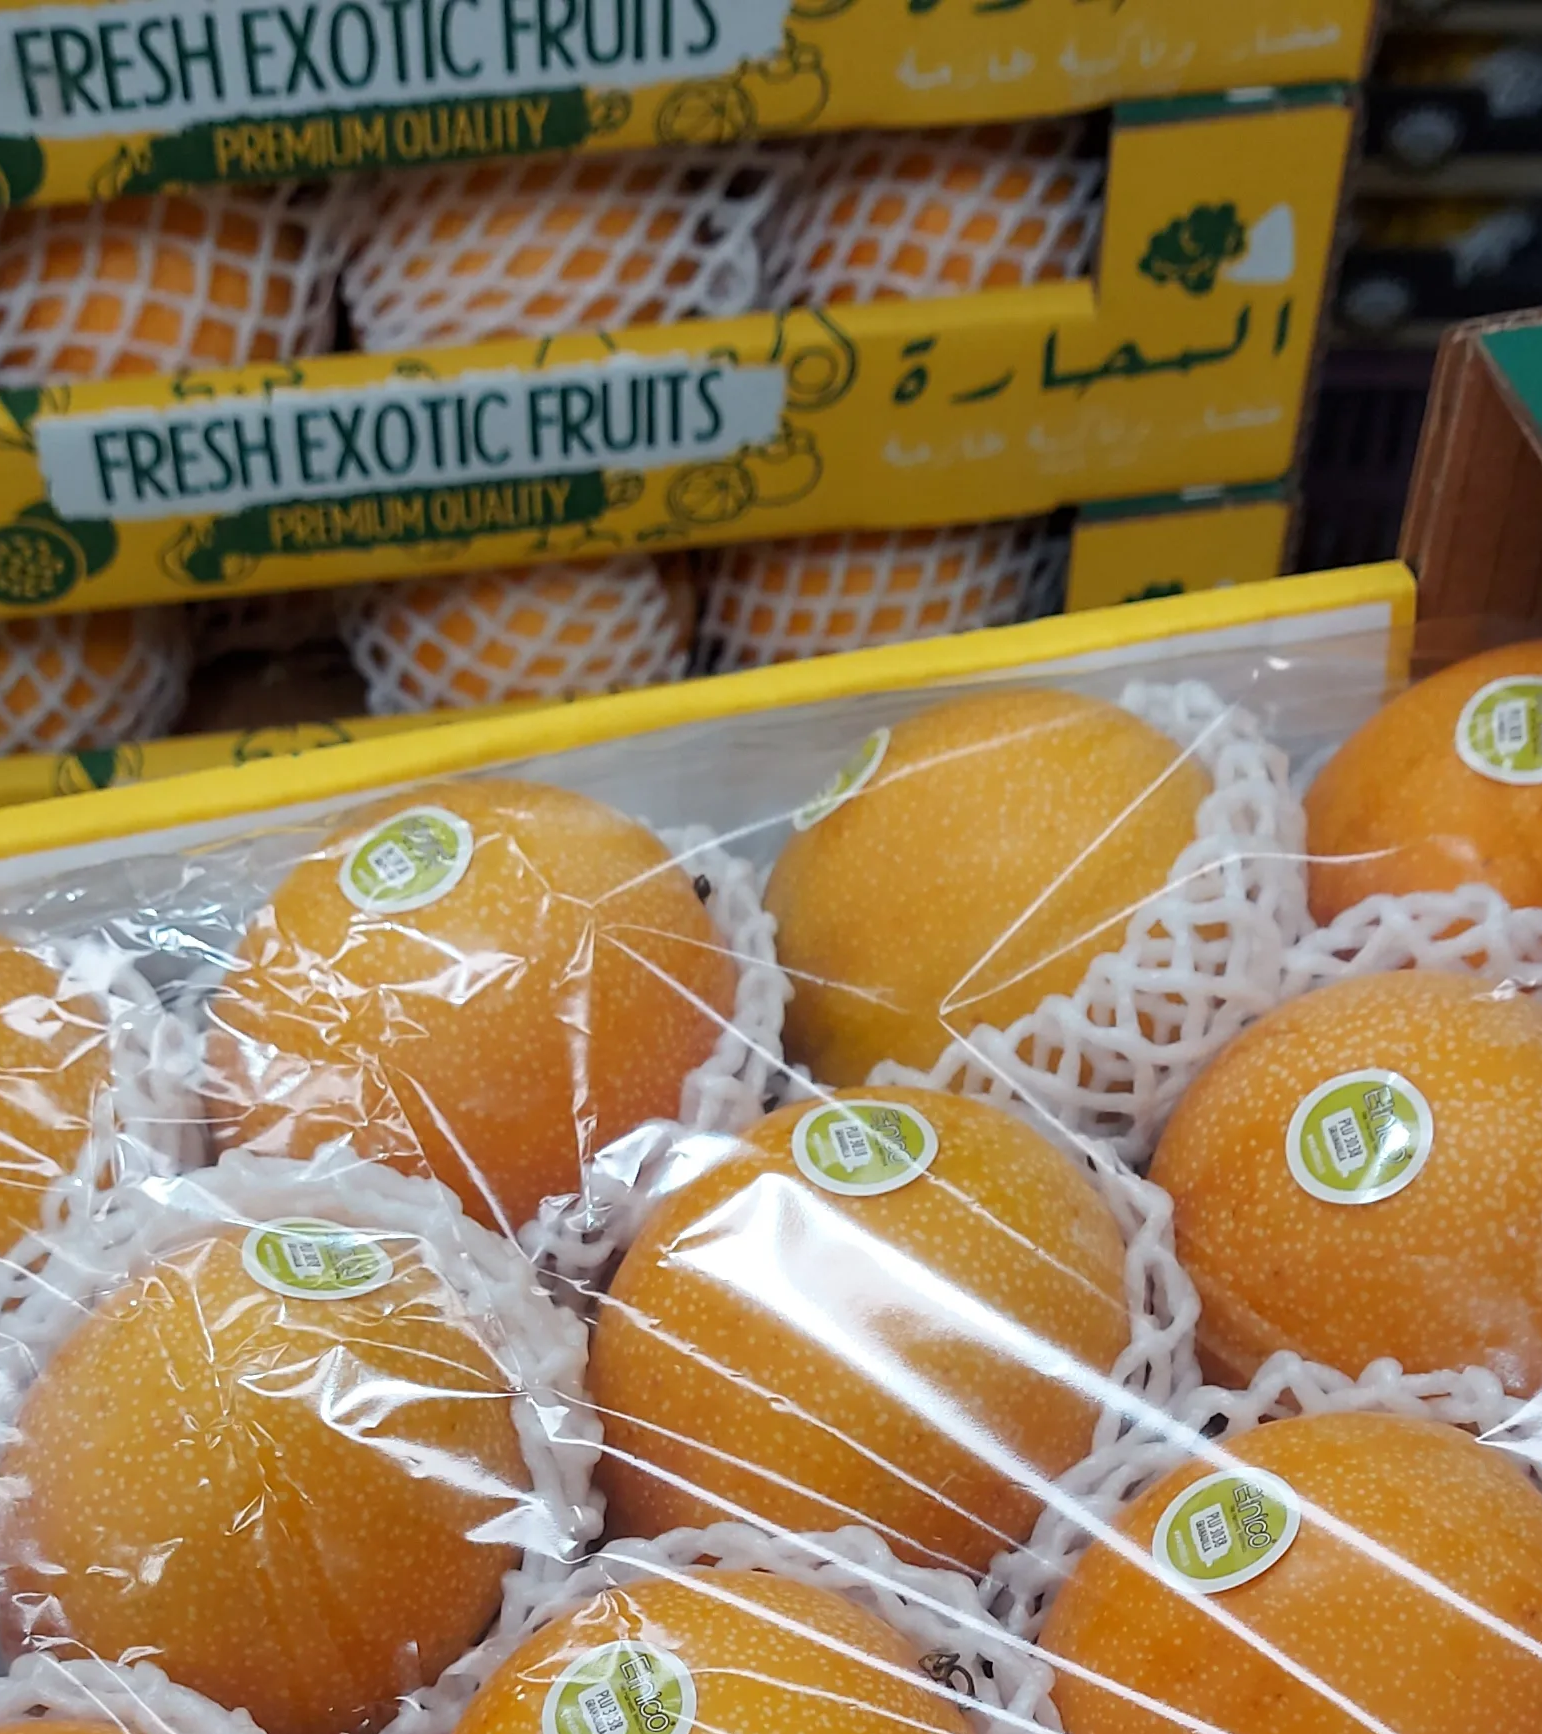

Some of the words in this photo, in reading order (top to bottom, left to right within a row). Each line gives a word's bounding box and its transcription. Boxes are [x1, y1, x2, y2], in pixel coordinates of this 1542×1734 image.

[14, 14, 226, 119] FRESH
[245, 0, 482, 98] EXOTIC
[505, 0, 720, 73] FRUITS
[215, 117, 387, 177] PREMIUM
[396, 98, 550, 157] QUALITY
[94, 413, 278, 503] FRESH
[295, 392, 511, 486] EXOTIC
[526, 369, 725, 463] FRUITS
[269, 494, 425, 548] PREMIUM
[431, 477, 572, 530] QUALITY
[596, 1689, 611, 1709] PLU
